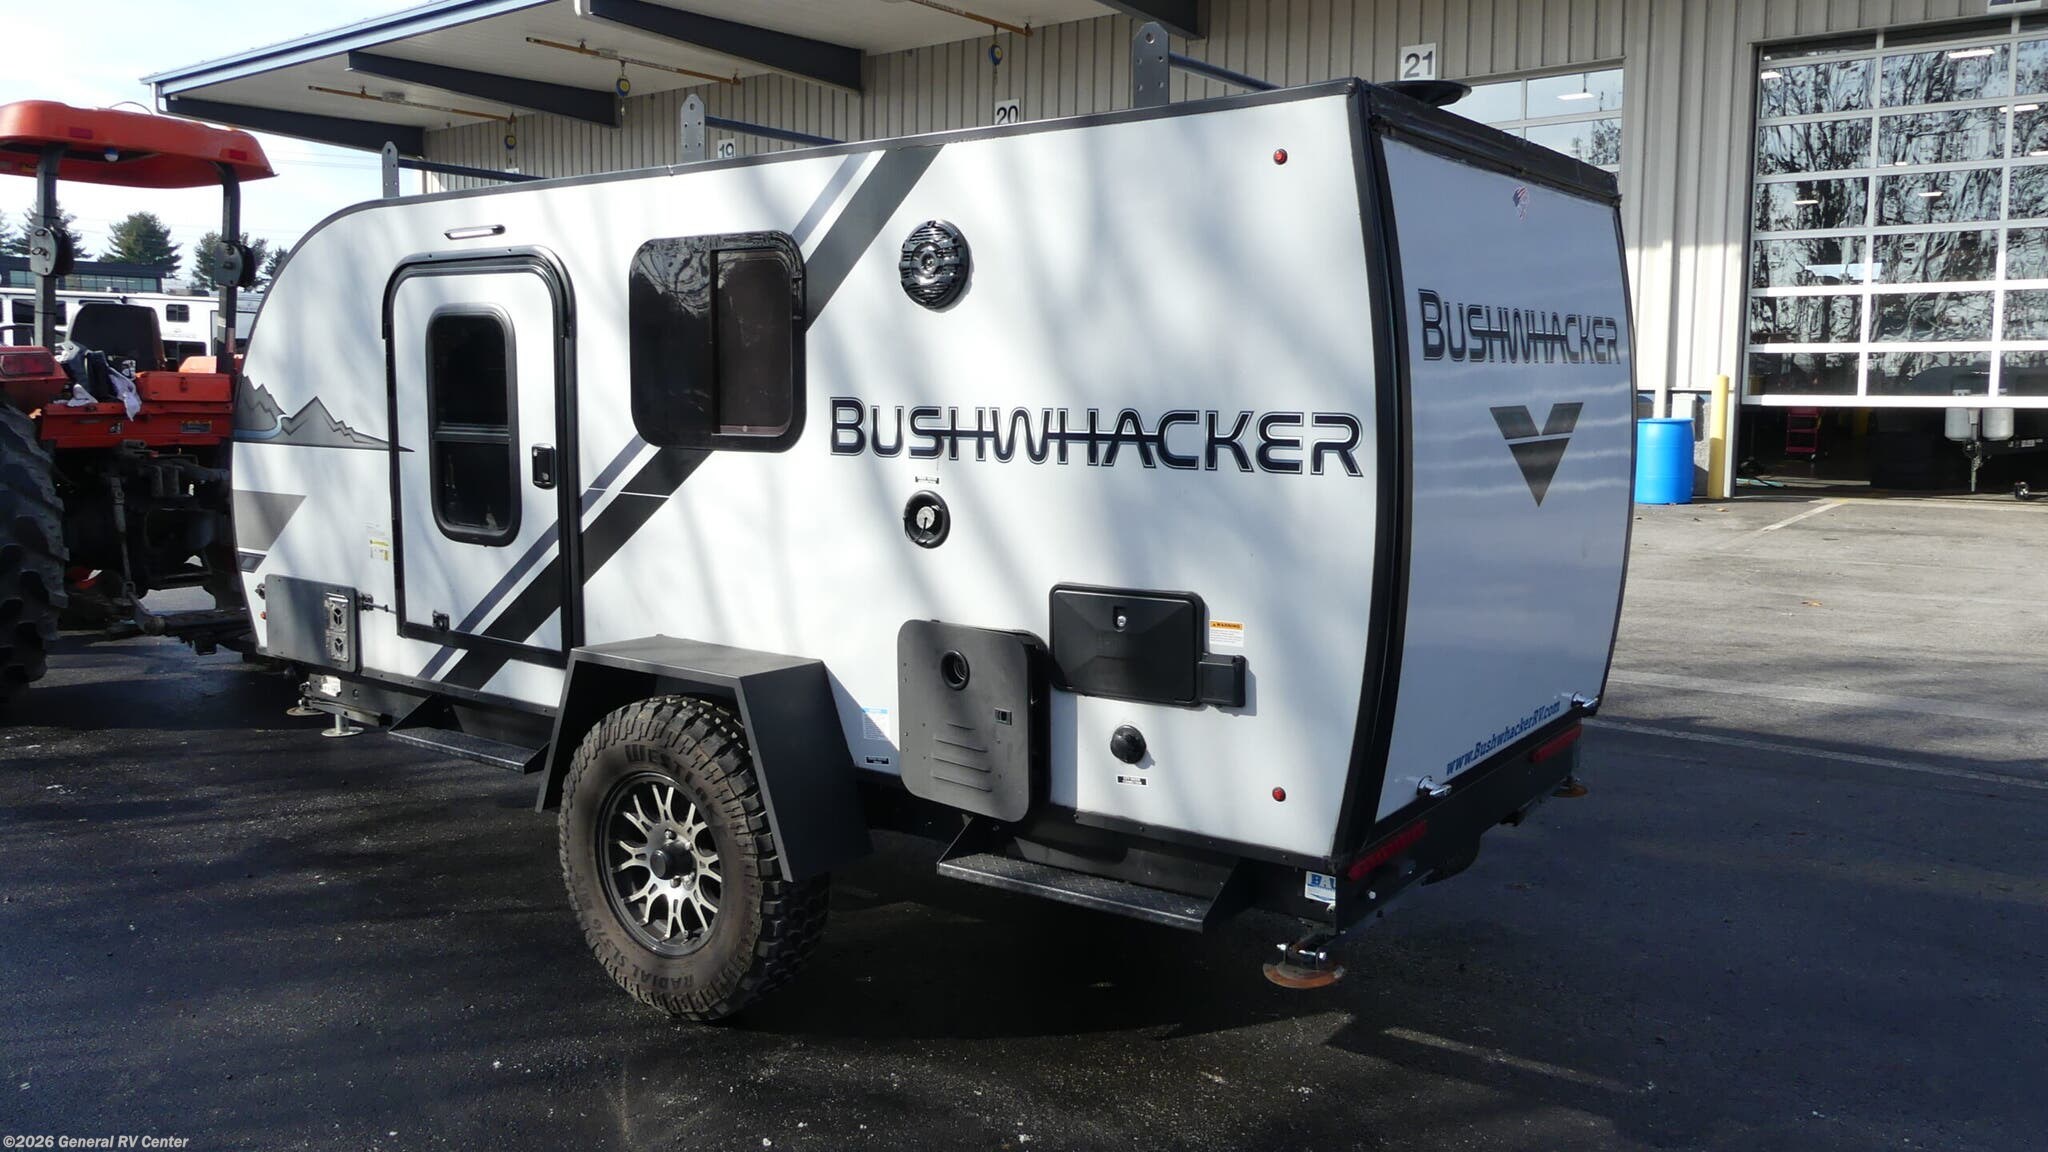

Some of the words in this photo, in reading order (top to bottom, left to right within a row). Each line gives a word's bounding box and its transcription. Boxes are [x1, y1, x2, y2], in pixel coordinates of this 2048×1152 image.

[1404, 51, 1432, 79] 21
[997, 105, 1018, 124] 20
[1418, 288, 1620, 364] BUSHWHACKER
[830, 397, 1364, 477] BUSHWHACKER
[1446, 701, 1561, 776] www.BushwhackerRV.com
